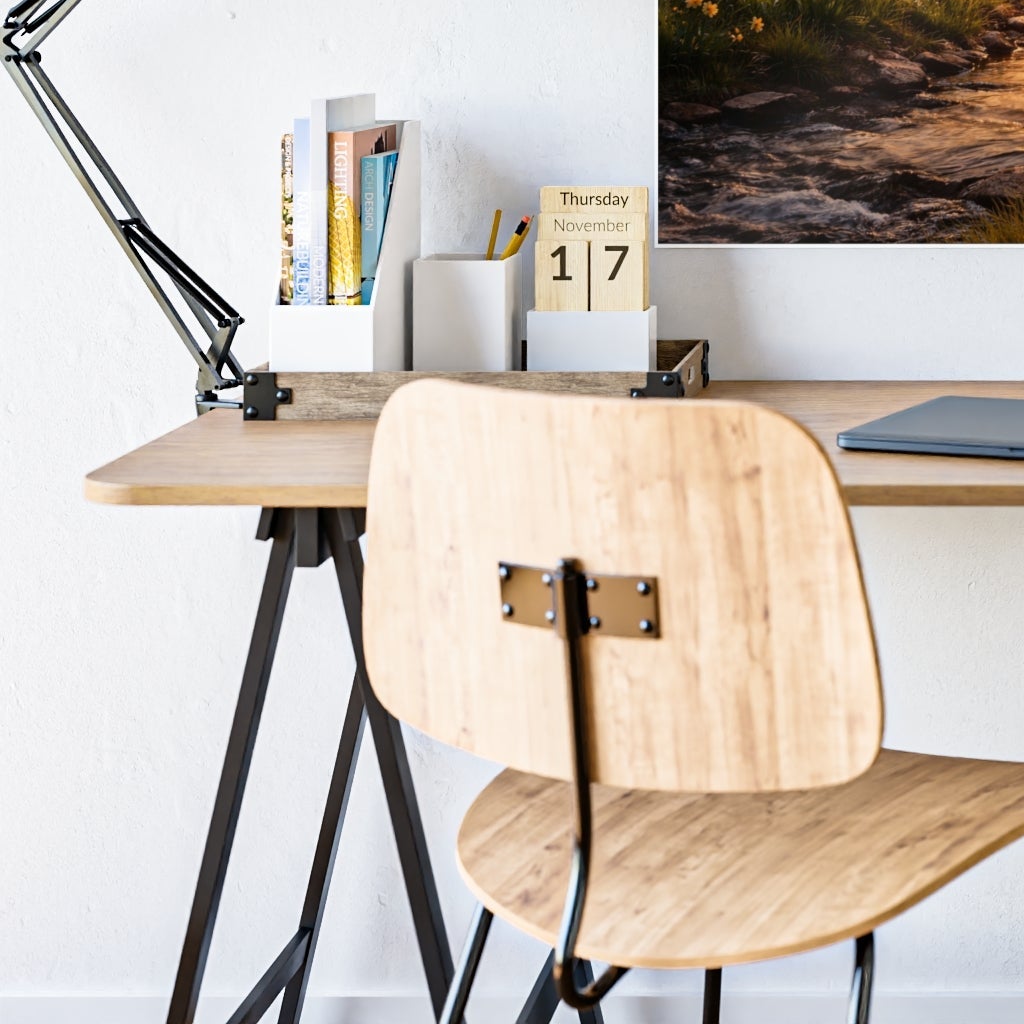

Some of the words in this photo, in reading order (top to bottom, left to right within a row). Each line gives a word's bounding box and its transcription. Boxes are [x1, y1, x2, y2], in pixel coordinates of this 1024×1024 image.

[334, 141, 348, 220] LIGHTING
[364, 161, 374, 190] ARCH
[364, 192, 374, 231] DESIGN
[560, 192, 629, 208] Thursday
[554, 219, 631, 232] November
[313, 245, 324, 304] MODERN
